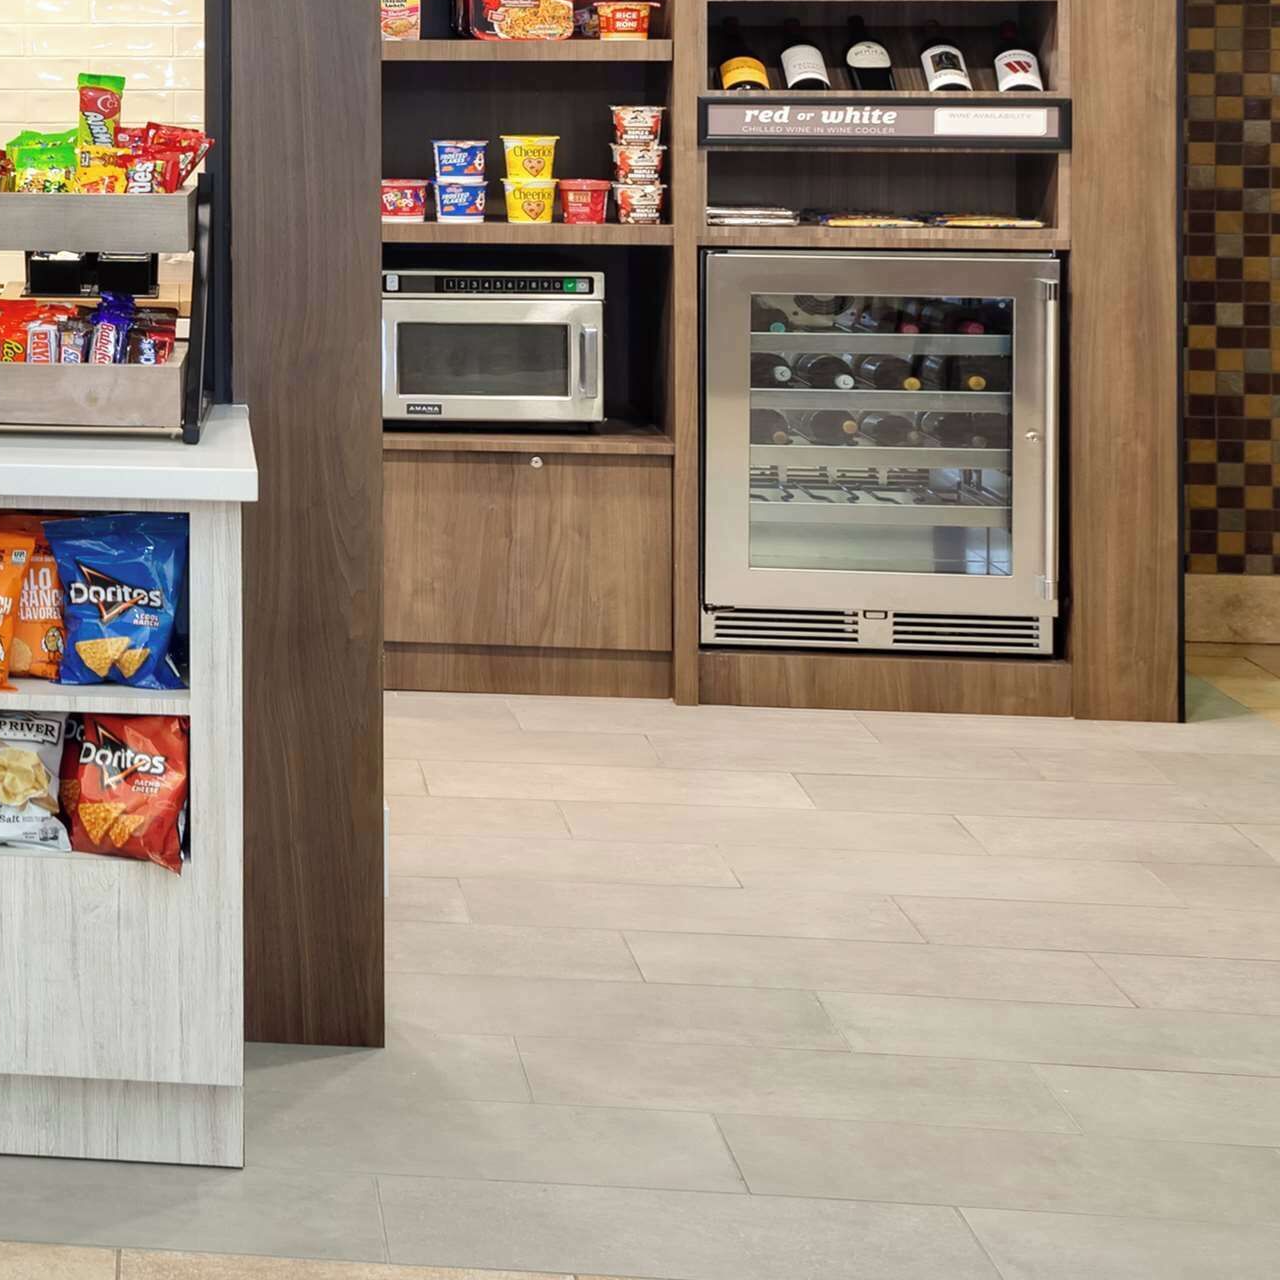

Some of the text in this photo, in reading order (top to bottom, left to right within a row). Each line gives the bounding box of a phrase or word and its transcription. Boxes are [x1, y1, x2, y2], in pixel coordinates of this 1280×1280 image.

[744, 106, 898, 124] red or white
[784, 126, 811, 134] WINE
[513, 145, 553, 158] Cheerios
[513, 188, 553, 201] Cheerios
[69, 581, 163, 608] Doritos
[9, 720, 56, 738] RIVER
[79, 742, 167, 775] Doritos
